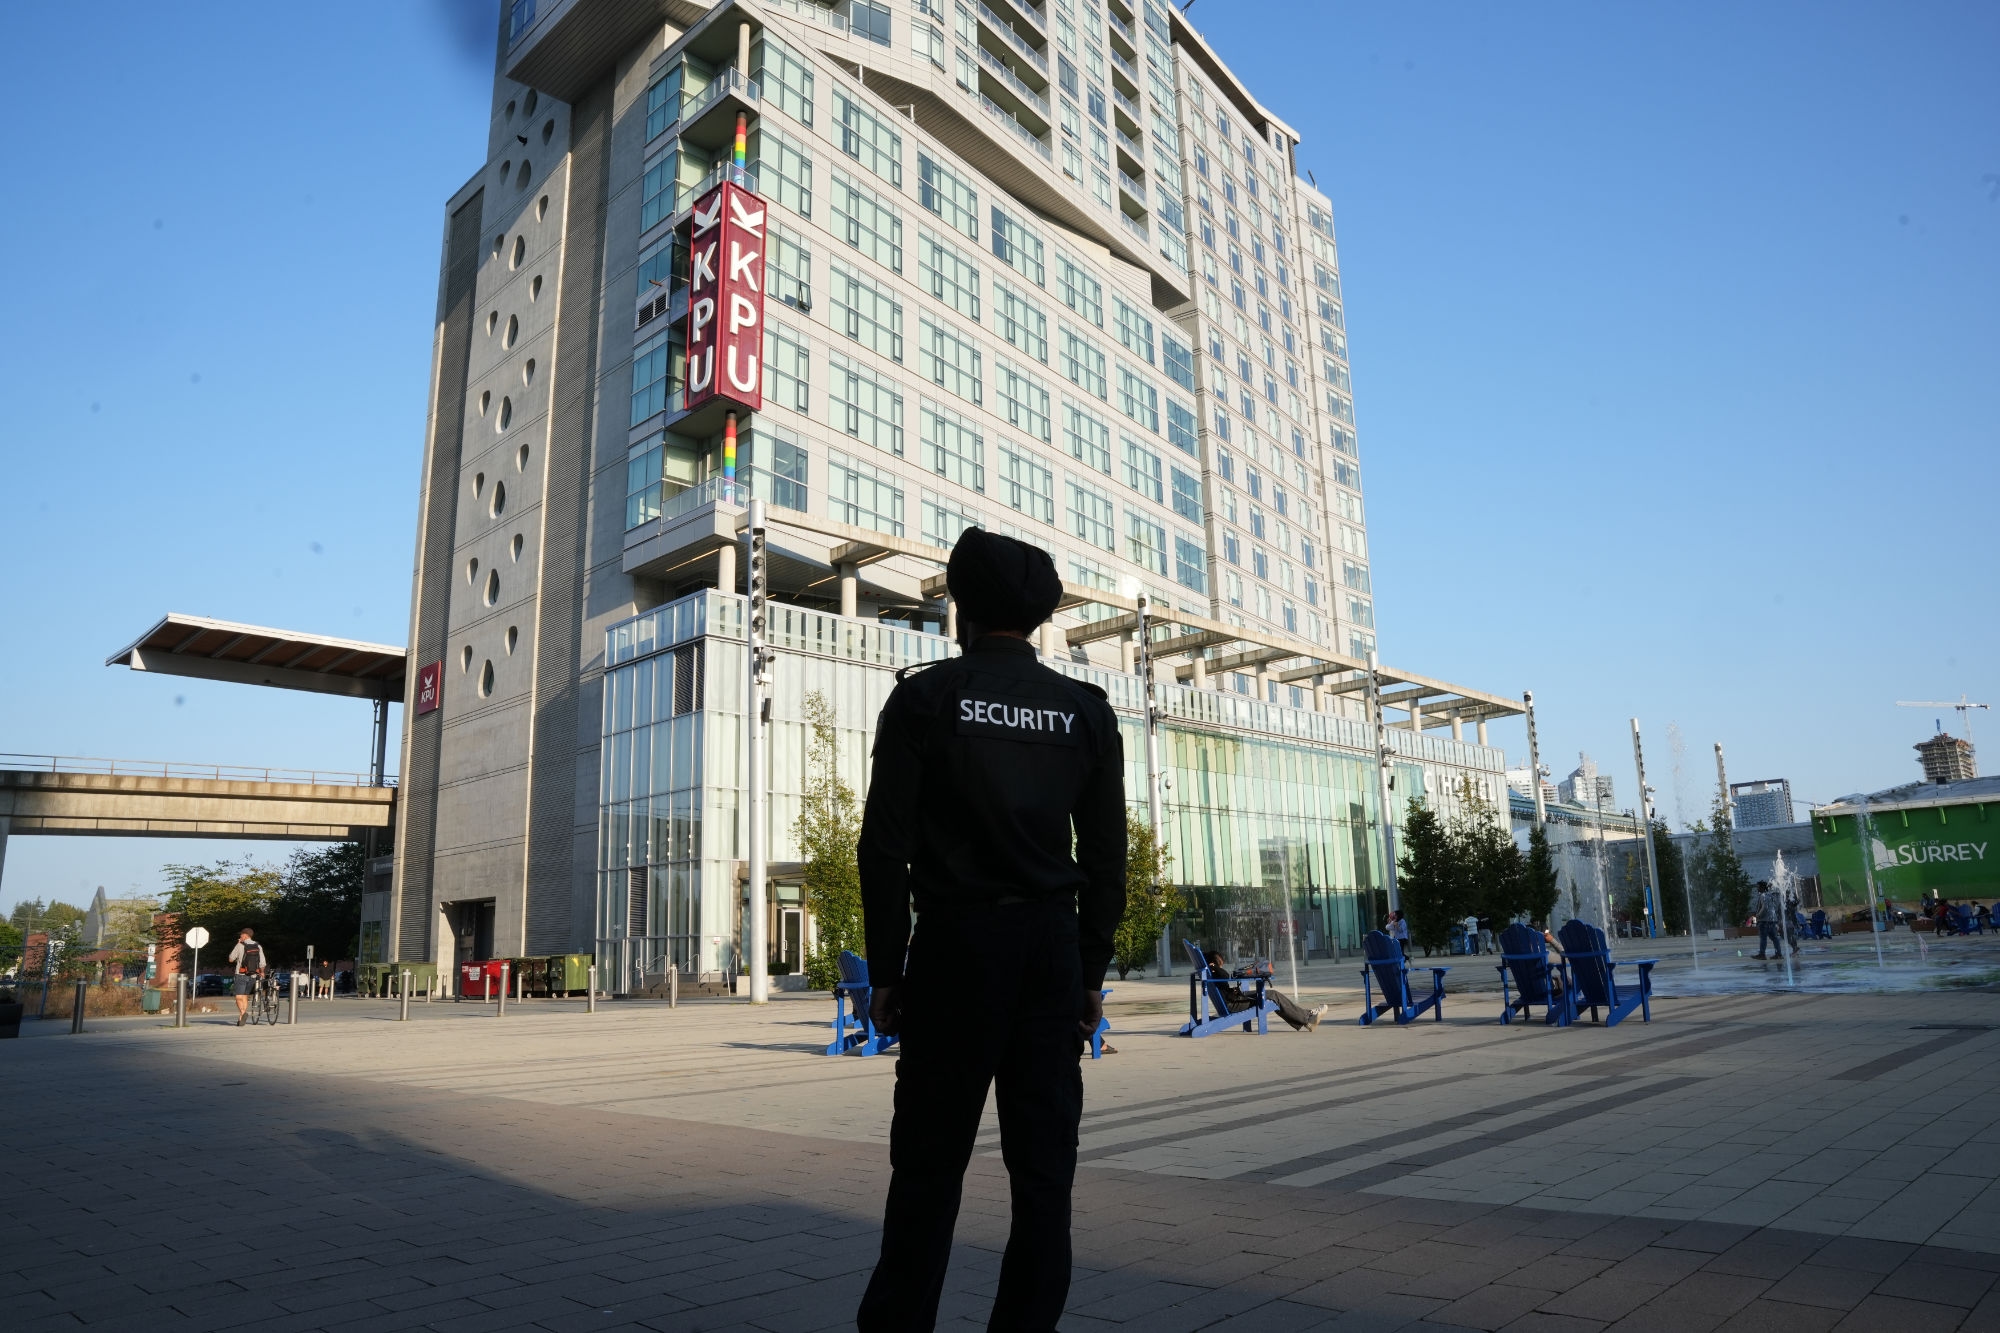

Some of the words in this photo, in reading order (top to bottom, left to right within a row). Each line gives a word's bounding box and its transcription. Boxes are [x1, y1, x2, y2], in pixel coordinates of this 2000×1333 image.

[690, 241, 717, 393] KPU
[727, 240, 759, 393] KPU
[420, 687, 435, 704] KPU
[960, 699, 1075, 734] SECURITY
[1898, 842, 1988, 865] SURREY
